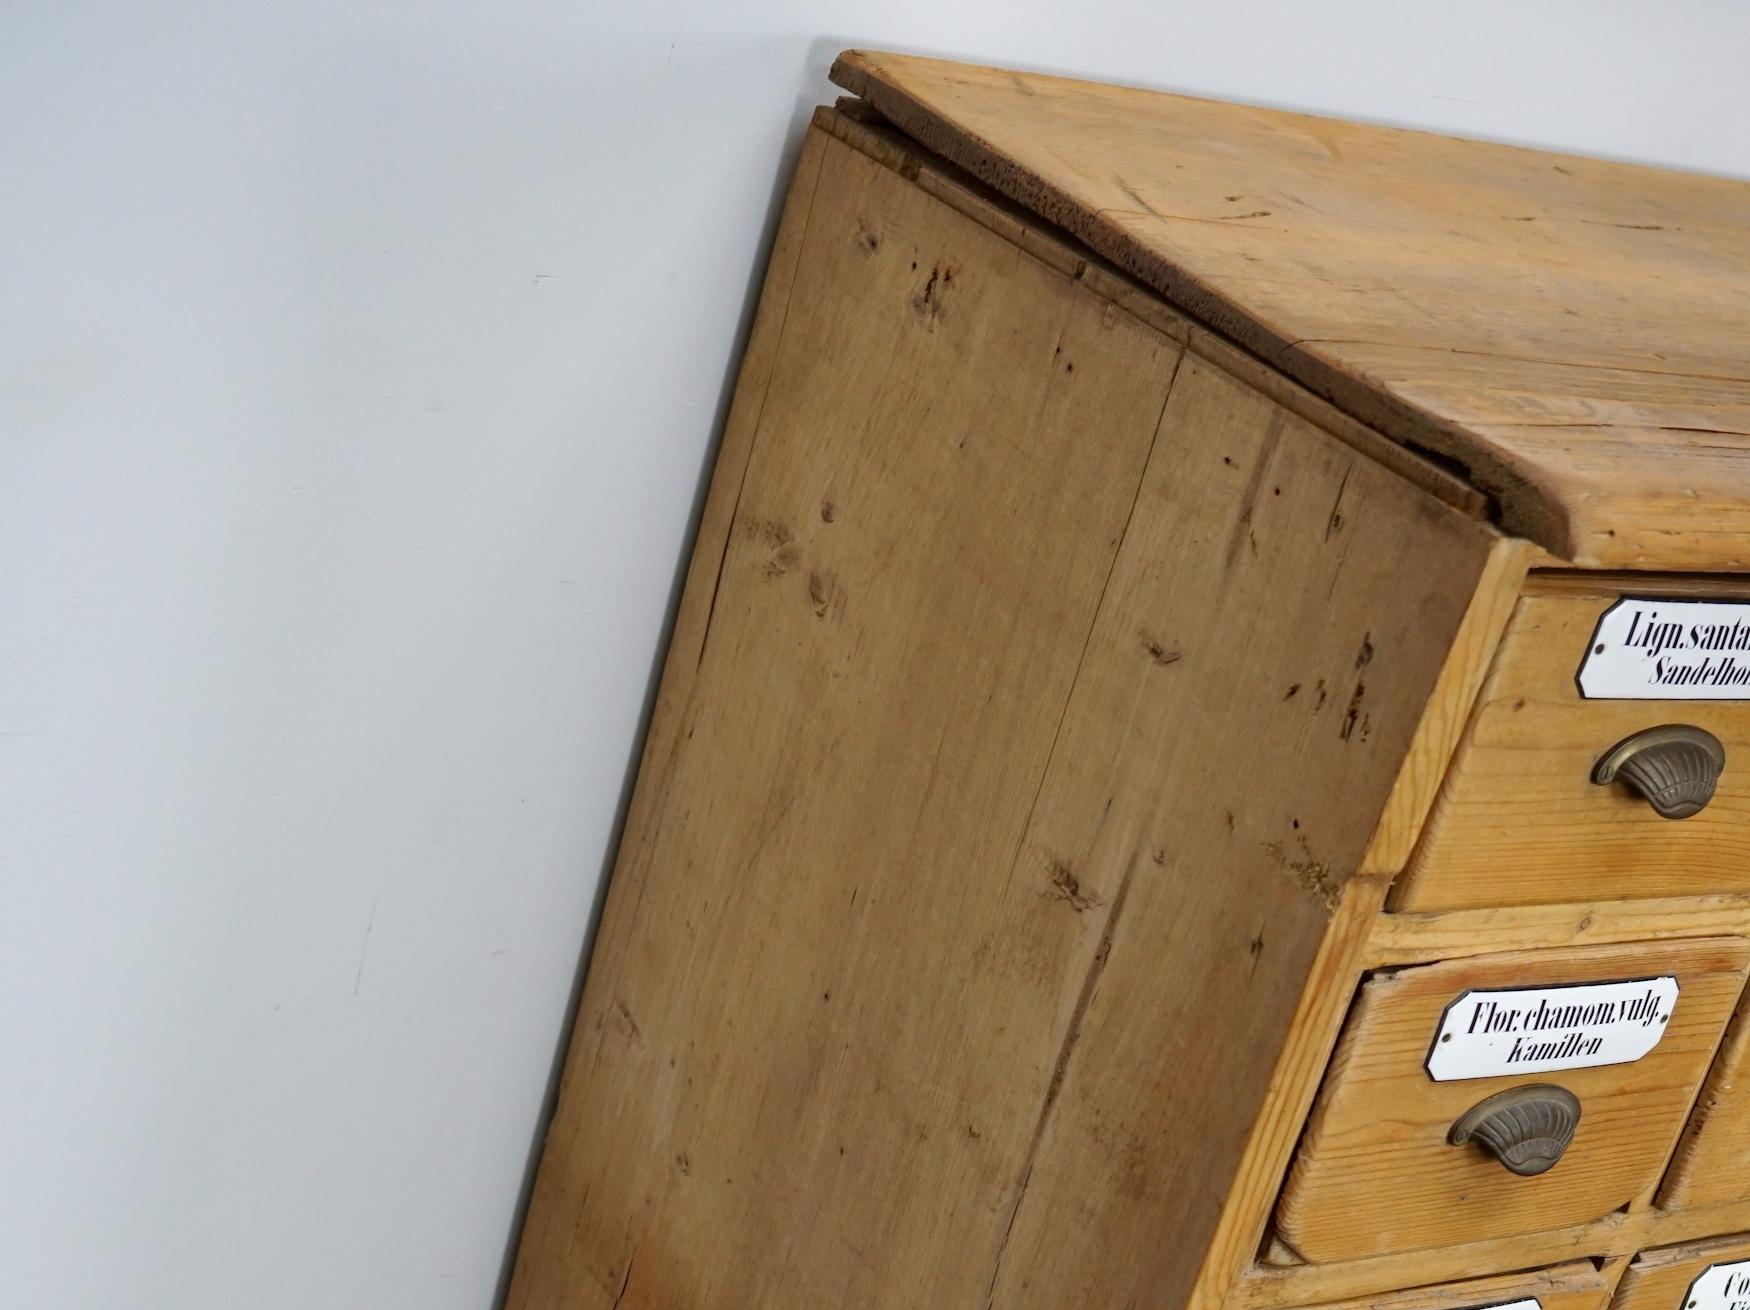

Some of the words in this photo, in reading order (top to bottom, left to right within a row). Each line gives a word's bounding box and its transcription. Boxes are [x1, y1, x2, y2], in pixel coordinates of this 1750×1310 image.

[1685, 616, 1750, 651] santa
[1467, 1001, 1517, 1034] Flor.
[1506, 1033, 1603, 1063] Kamillen
